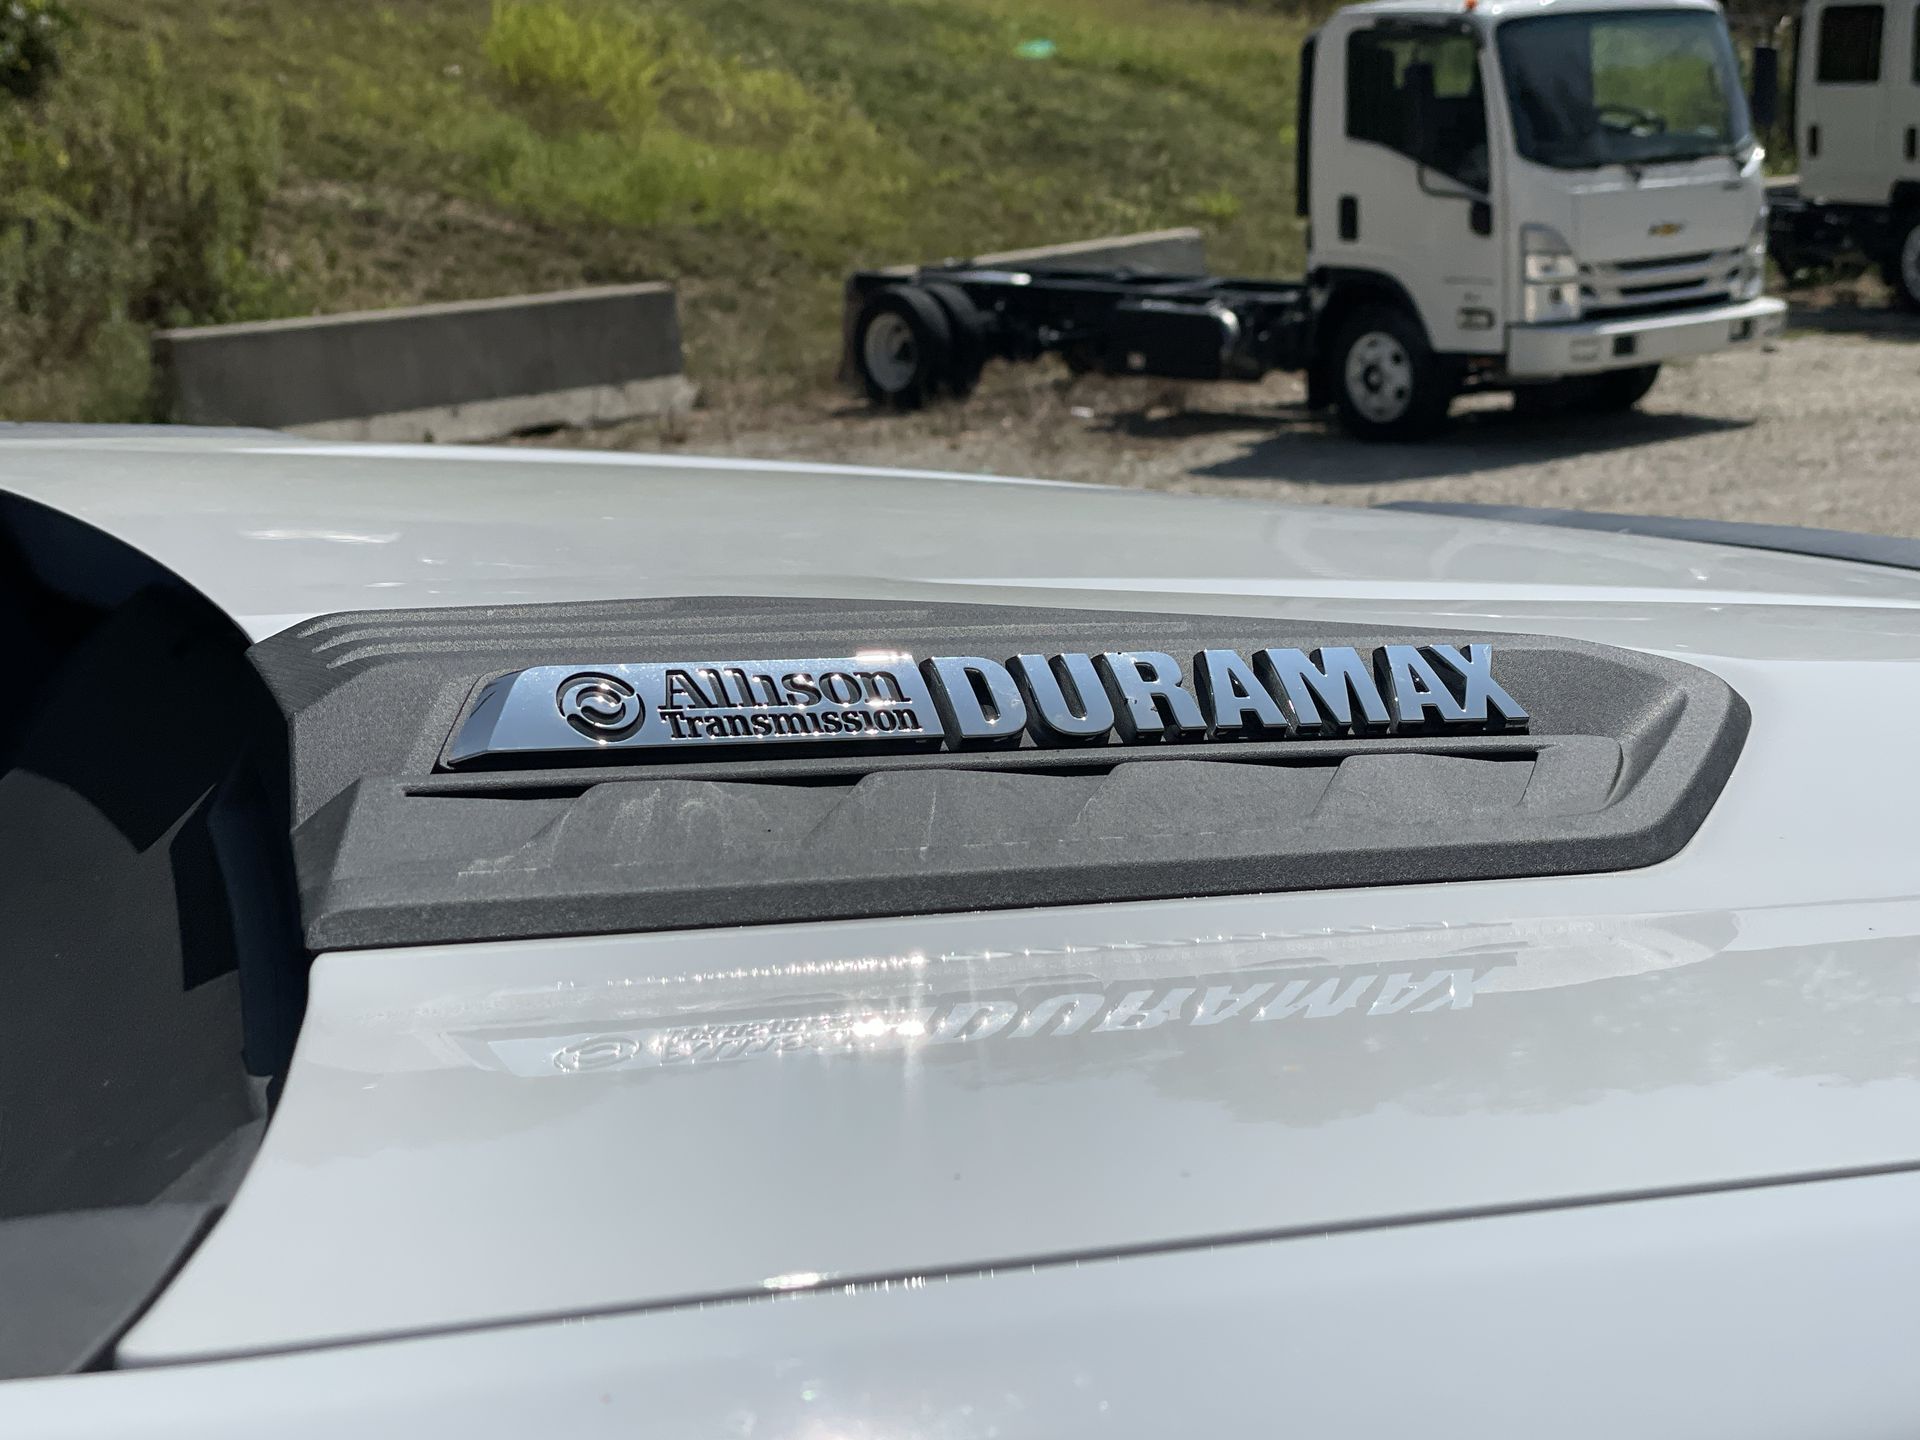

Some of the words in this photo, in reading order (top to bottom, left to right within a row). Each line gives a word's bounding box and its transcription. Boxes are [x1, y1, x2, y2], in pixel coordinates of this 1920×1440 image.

[659, 667, 912, 711] Allison
[922, 643, 1529, 742] DURAMAX
[660, 709, 923, 740] Transmission
